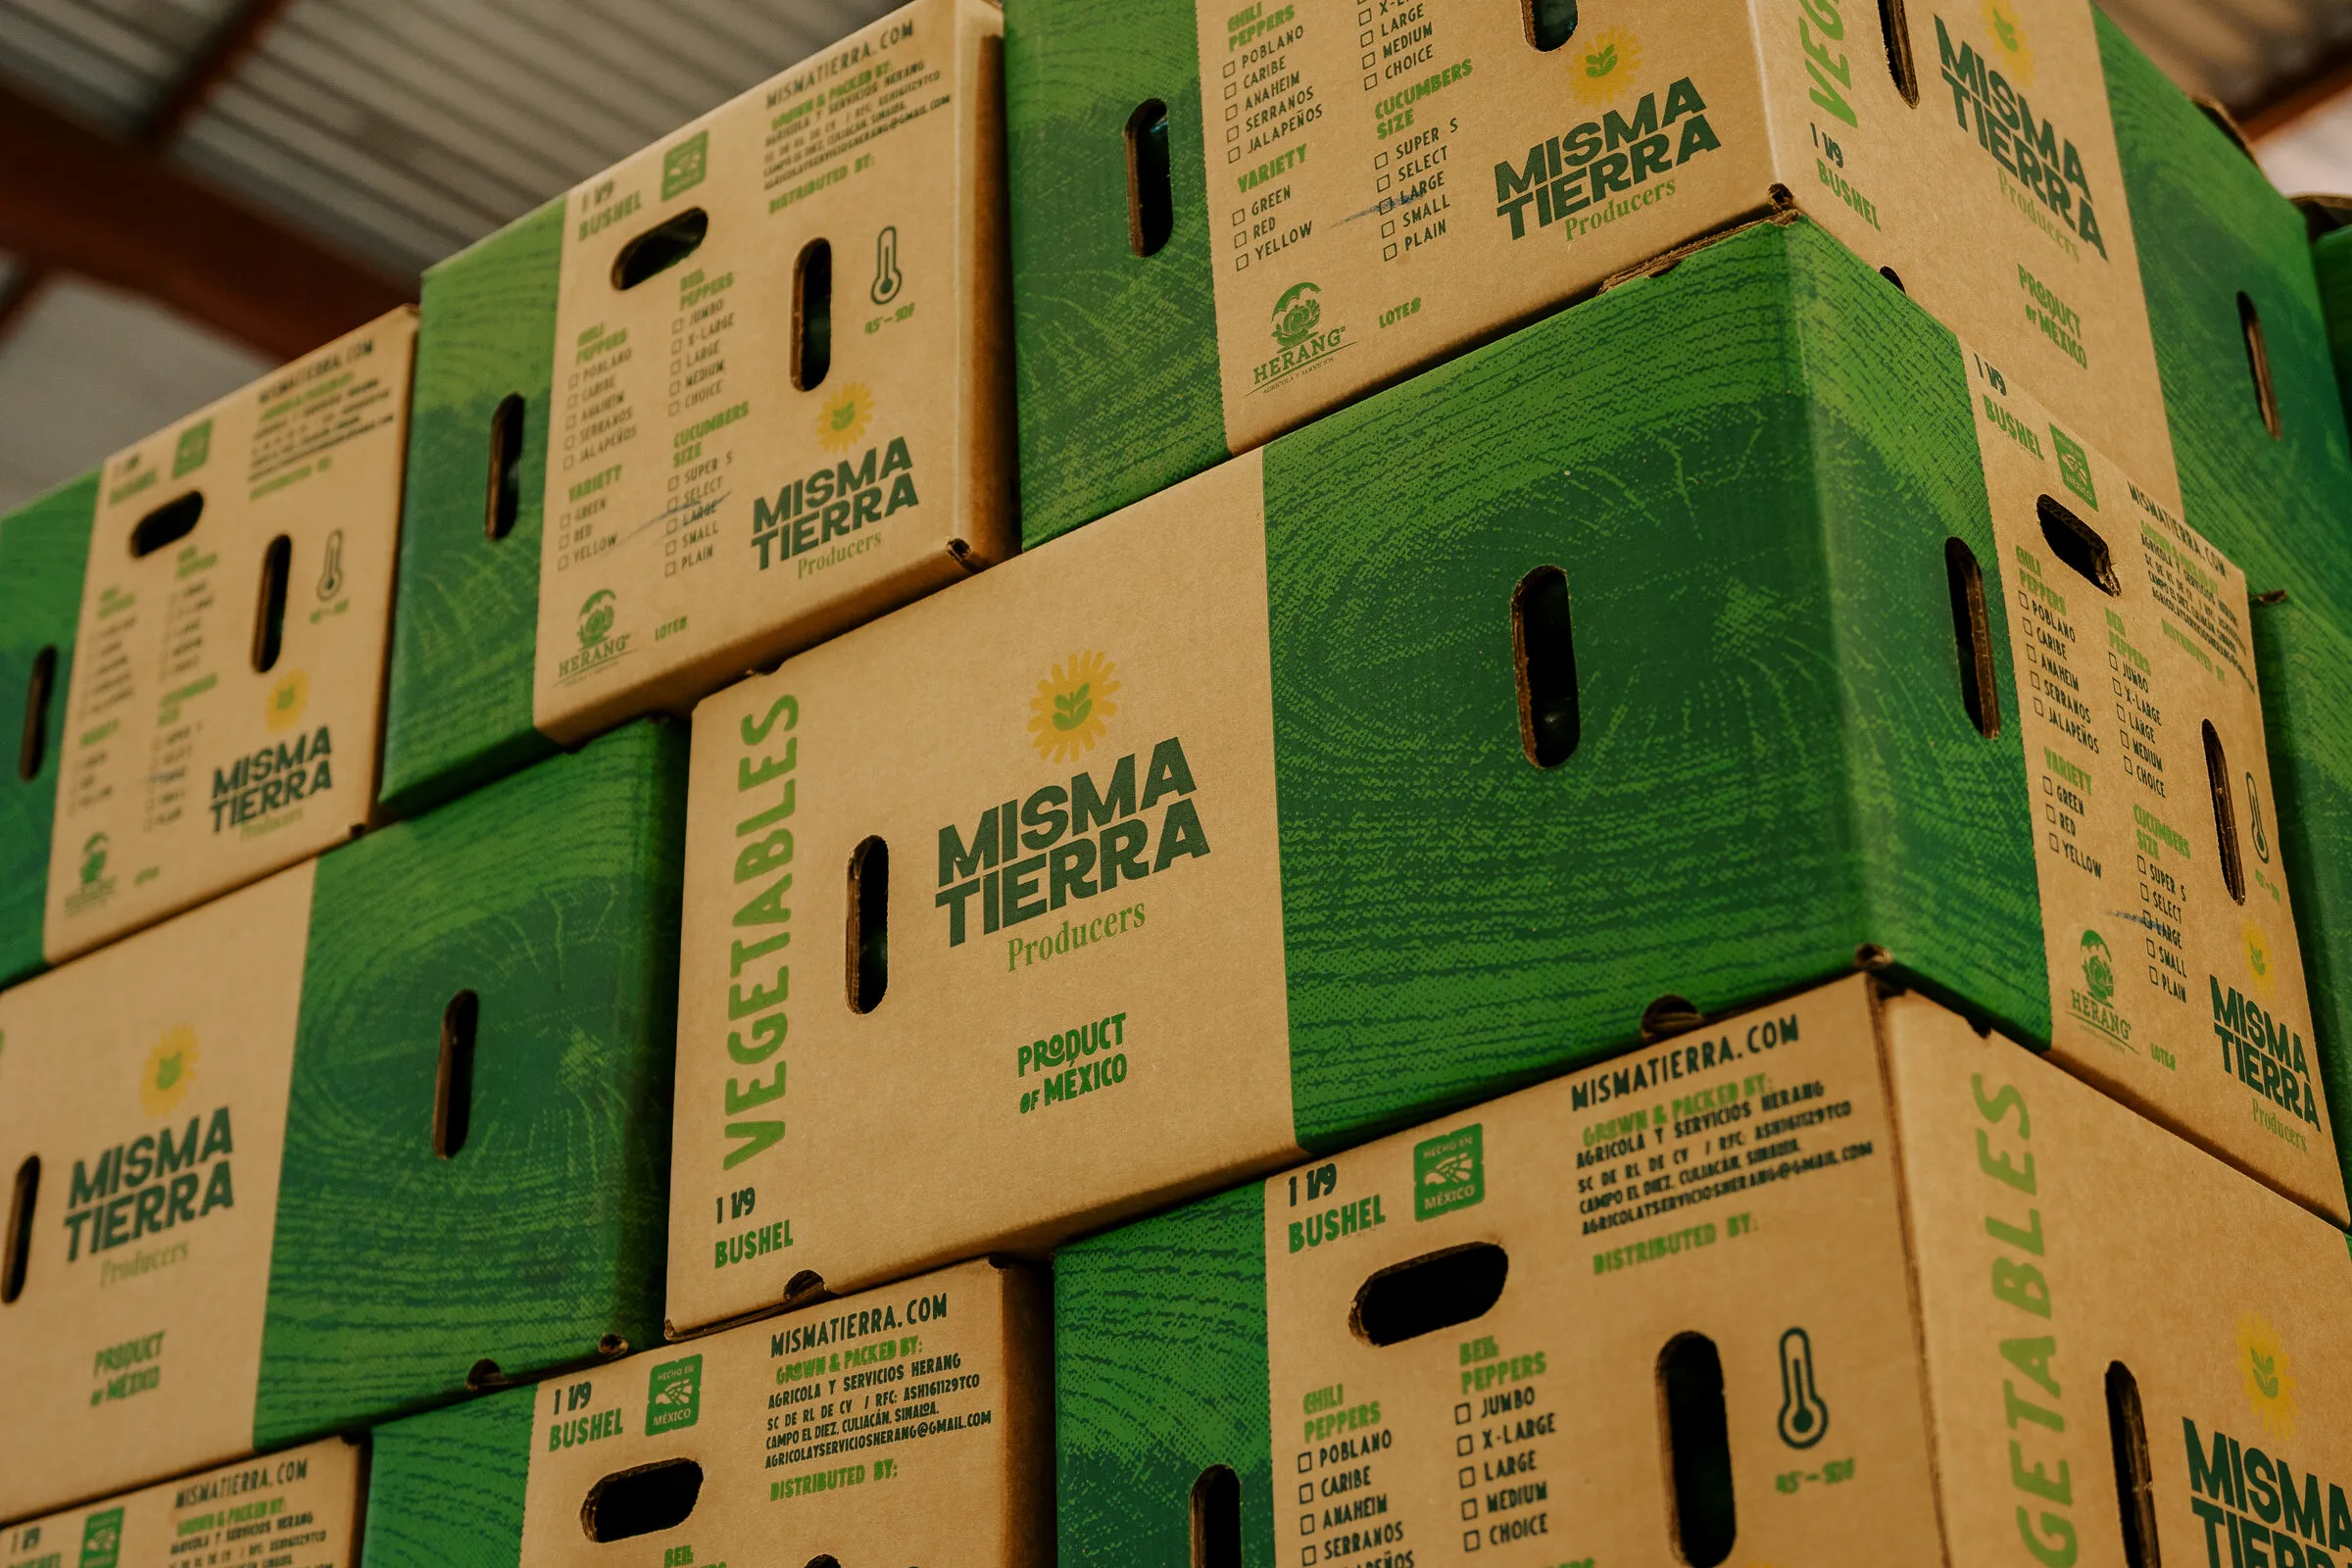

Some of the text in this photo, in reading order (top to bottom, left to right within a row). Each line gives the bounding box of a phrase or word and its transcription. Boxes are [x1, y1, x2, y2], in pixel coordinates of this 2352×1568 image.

[1227, 1, 1262, 32] CHILI
[1229, 5, 1295, 52] PEPPERS
[1381, 3, 1424, 36] LARGE
[1242, 25, 1303, 69] POBLANO
[1383, 23, 1433, 59] MEDIUM
[1385, 45, 1434, 78] CHOICE
[766, 19, 913, 110] MISMATIERRA.COM
[1244, 55, 1286, 89] CARIBE
[1246, 71, 1300, 111] ANAHEIM
[1246, 86, 1314, 132] SERRANOS
[1375, 59, 1473, 120] CUCUMBERS
[1934, 14, 2092, 205] MISMA
[1248, 104, 1323, 154] JALAPEÑOS
[1377, 109, 1414, 139] SIZE
[1396, 118, 1458, 159] SUPER S
[1494, 76, 1707, 203] MISMA
[1238, 143, 1306, 193] VARIETY
[1398, 146, 1447, 181] SELECT
[1496, 114, 1721, 241] TIERRA
[1940, 65, 2108, 263] TIERRA
[1251, 185, 1291, 216] GREEN
[1400, 172, 1445, 204] LARGE
[1817, 158, 1881, 232] BUSHEL
[579, 190, 641, 241] BUSHEL
[1253, 217, 1275, 239] RED
[1403, 195, 1450, 227] SMALL
[1564, 179, 1676, 241] Producers
[1997, 167, 2079, 264] Producers
[1255, 220, 1312, 260] YELLOW
[1404, 219, 1446, 252] PLAIN
[2018, 264, 2082, 340] PRODUCT
[685, 379, 722, 409] CHOICE
[686, 360, 723, 387] MEDIUM
[674, 401, 749, 448] CUCUMBERS
[1983, 393, 2044, 462] BUSHEL
[673, 442, 702, 467] SIZE
[685, 458, 718, 484] SUPER
[568, 464, 622, 504] VARIETY
[685, 476, 722, 503] SELECT
[753, 437, 912, 535] MISMA
[574, 523, 592, 542] RED
[682, 521, 718, 548] SMALL
[751, 472, 919, 571] TIERRA
[2127, 480, 2227, 580] MISMATIERRA.COM
[574, 532, 617, 563] YELLOW
[681, 545, 712, 570] PLAIN
[797, 529, 881, 579] Producers
[2016, 545, 2041, 578] CHILI
[2019, 567, 2066, 616] PEPPERS
[2033, 600, 2076, 643] POBLANO
[2037, 627, 2067, 661] CARIBE
[2041, 654, 2079, 692] ANAHEIM
[2123, 662, 2148, 694] JUMBO
[2044, 680, 2091, 724] SERRANOS
[2125, 686, 2161, 727] X-LARGE
[2048, 708, 2099, 755] JALAPEÑOS
[2129, 712, 2155, 745] LARGE
[212, 725, 331, 799] MISMA
[2044, 746, 2091, 796] VARIETY
[2132, 738, 2163, 772] MEDIUM
[209, 760, 332, 834] TIERRA
[2057, 785, 2084, 815] GREEN
[2136, 765, 2166, 799] CHOICE
[938, 737, 1197, 887] MISMA
[2060, 812, 2076, 836] RED
[935, 799, 1210, 948] TIERRA
[2062, 840, 2101, 879] YELLOW
[2149, 863, 2185, 902] SUPER S
[2153, 891, 2181, 924] SELECT
[722, 693, 800, 1171] VEGETABLES
[1007, 903, 1146, 972] Producers
[2156, 917, 2182, 950] LARGE
[2159, 946, 2187, 978] SMALL
[2162, 973, 2186, 1004] PLAIN
[1018, 1012, 1126, 1077] PRODUCT
[2210, 974, 2311, 1084] MISMA
[1044, 1059, 1127, 1106] MÉXICO
[1572, 1014, 1798, 1111] MISMATIERRA.COM
[2214, 1022, 2321, 1134] TIERRA
[1654, 1127, 1663, 1144] Y
[1674, 1102, 1751, 1140] SERVICIOS
[2252, 1098, 2307, 1152] Producers
[69, 1106, 232, 1209] MISMA
[64, 1160, 233, 1262] TIERRA
[1289, 1195, 1386, 1254] BUSHEL
[714, 1220, 794, 1269] BUSHEL
[1592, 1223, 1716, 1275] DISTRIBUTED
[771, 1293, 947, 1358] MISMATIERRA.COM
[658, 1368, 682, 1380] HECHO
[768, 1352, 960, 1409] AGRICOLA Y SERVICIOS HERANG
[776, 1335, 923, 1385] GROWN & PACKED BY:
[1461, 1351, 1546, 1396] PEPPERS
[767, 1417, 779, 1431] SC
[785, 1412, 797, 1427] DE
[804, 1408, 815, 1422] RL
[821, 1404, 833, 1418] DE
[840, 1399, 852, 1414] CV
[875, 1391, 898, 1407] RFC:
[1302, 1384, 1343, 1415] CHILI
[1481, 1387, 1535, 1419] JUMBO
[549, 1408, 623, 1451] BUSHEL
[765, 1431, 799, 1449] CAMPO
[802, 1428, 811, 1442] EL
[1304, 1400, 1381, 1444] PEPPERS
[1483, 1412, 1556, 1449] X-LARGE
[1319, 1429, 1392, 1467] POBLANO
[1484, 1450, 1537, 1482] LARGE
[175, 1458, 307, 1508] MISMATIERRA.COM
[770, 1458, 898, 1501] DISTRIBUTED BY:
[1322, 1466, 1371, 1497] CARIBE
[1487, 1482, 1546, 1513] MEDIUM
[1323, 1494, 1388, 1529] ANAHEIM
[1490, 1513, 1547, 1545] CHOICE
[1324, 1522, 1403, 1559] SERRANOS
